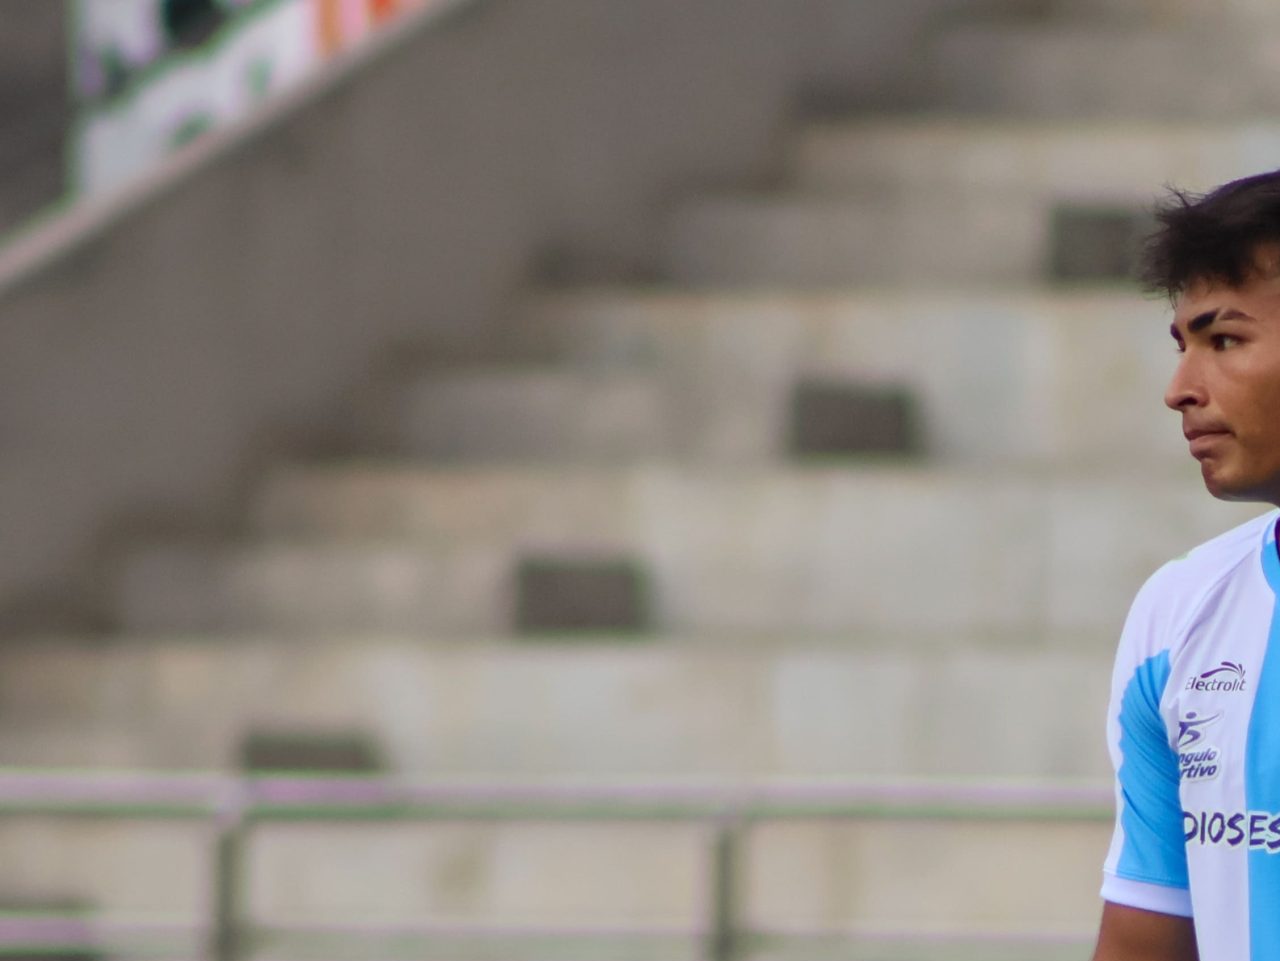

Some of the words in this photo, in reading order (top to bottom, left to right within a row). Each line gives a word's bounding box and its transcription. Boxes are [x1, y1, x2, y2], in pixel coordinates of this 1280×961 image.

[1185, 676, 1246, 692] Electrolit
[1179, 748, 1217, 766] ngulo
[1181, 764, 1217, 778] rtivo
